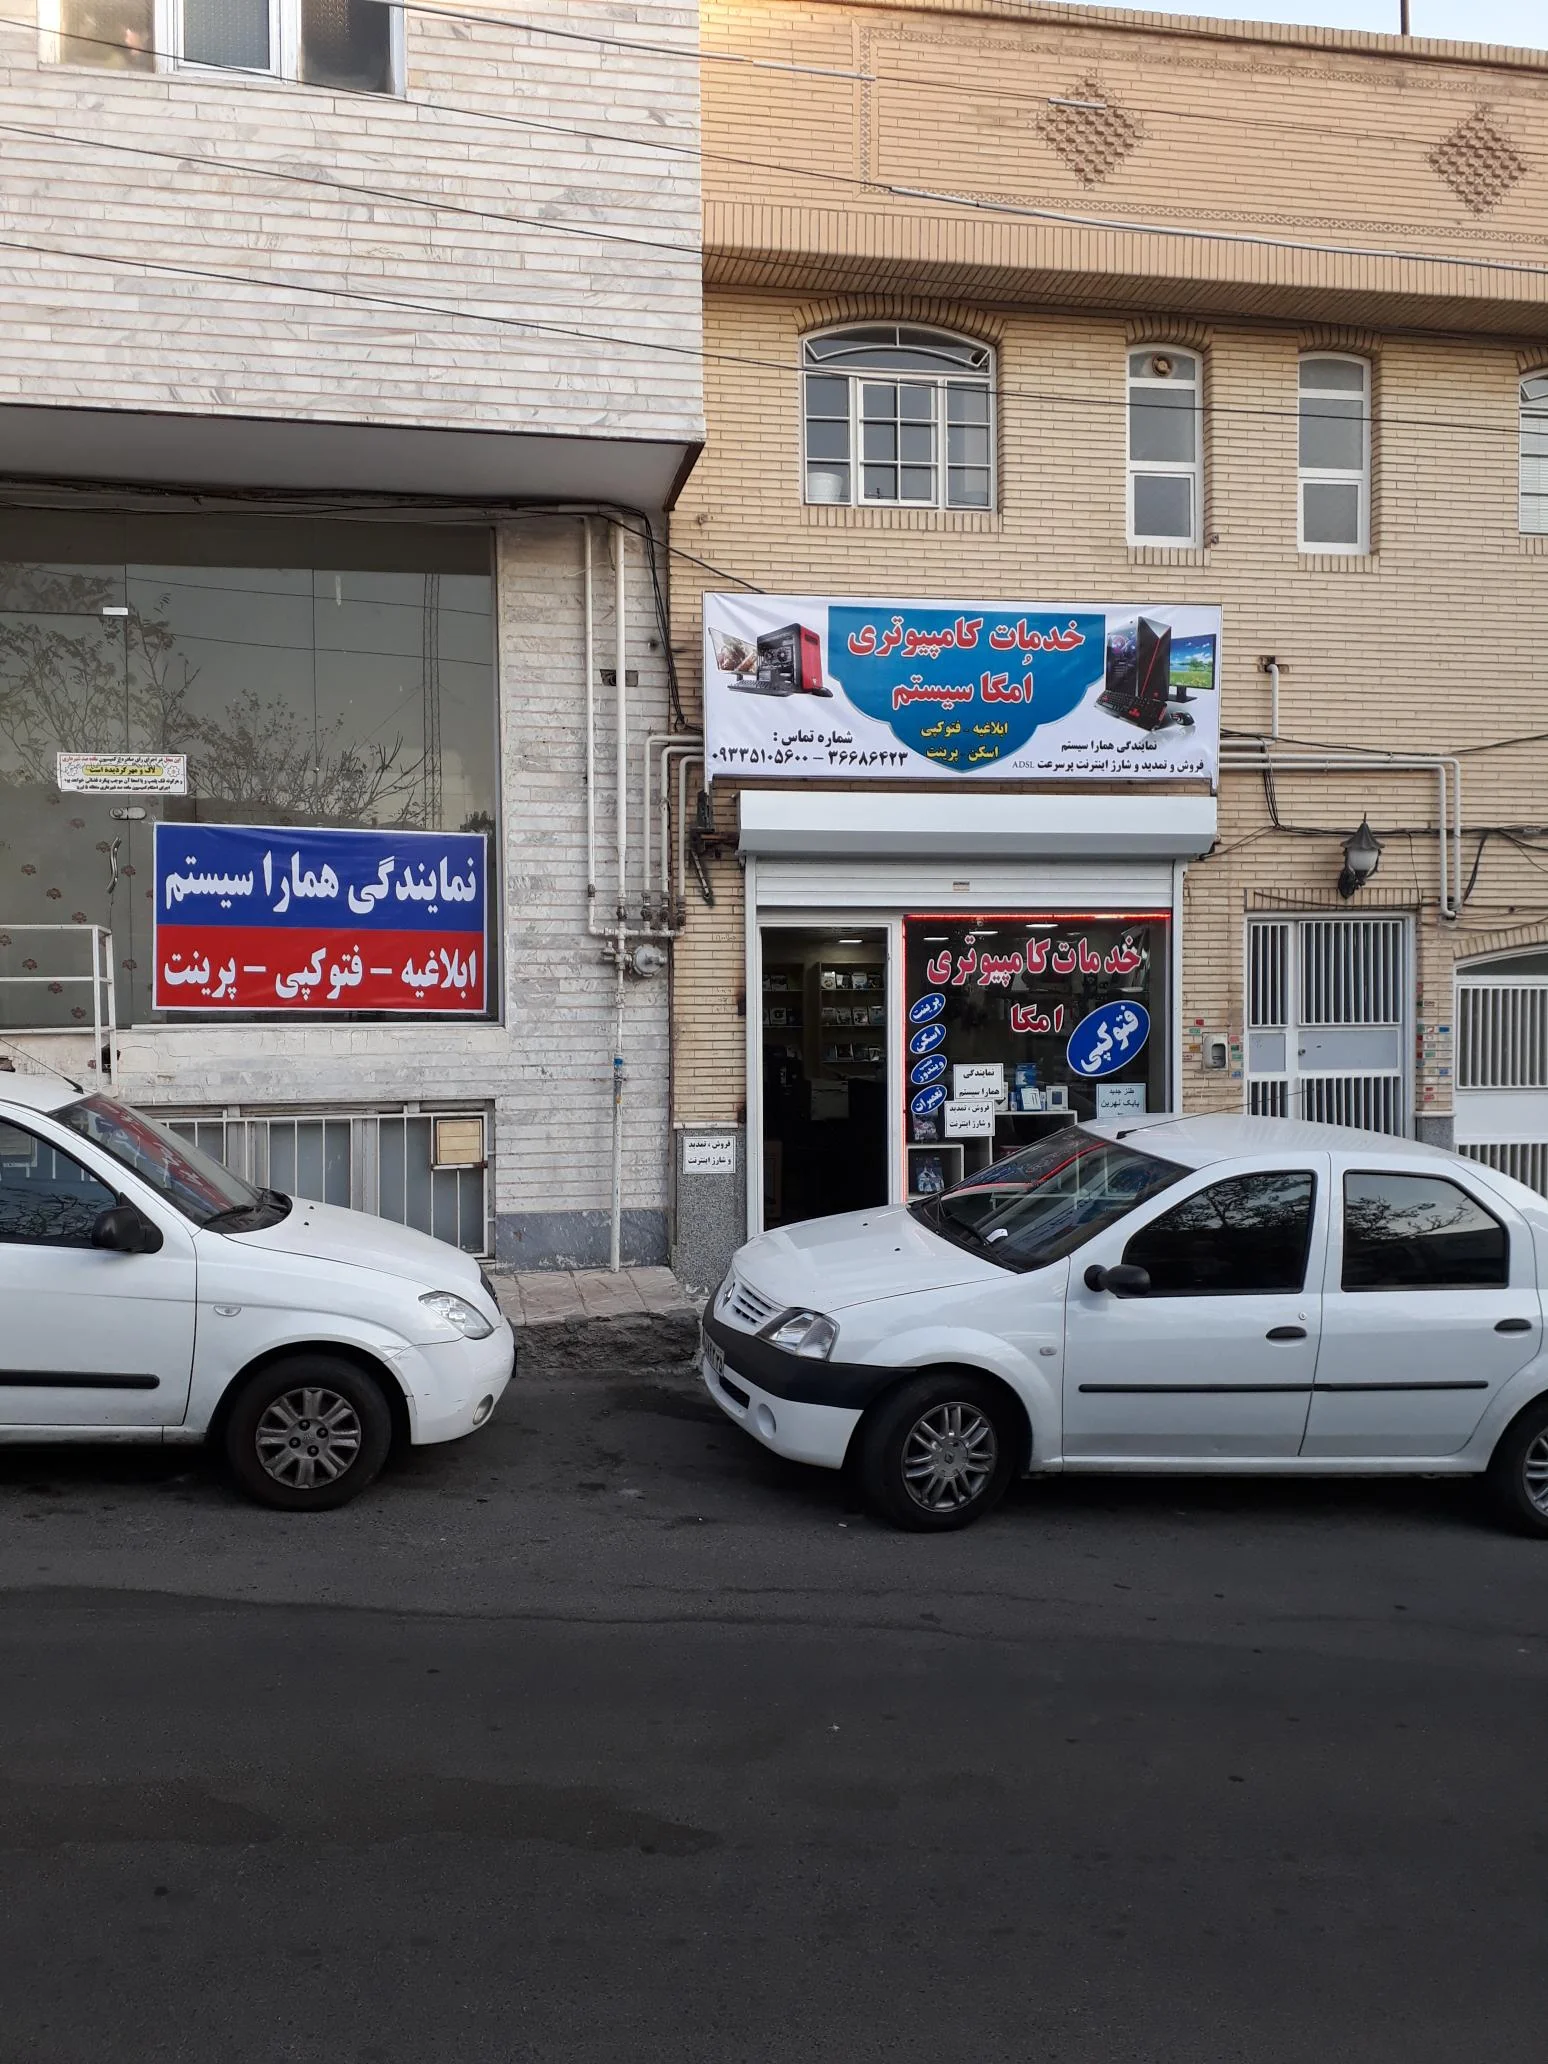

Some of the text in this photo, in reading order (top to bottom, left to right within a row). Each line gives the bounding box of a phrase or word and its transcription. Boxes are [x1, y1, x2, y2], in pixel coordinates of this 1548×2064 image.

[847, 616, 1086, 659] خدمات کامپیوتری
[892, 675, 974, 710] سیستم
[781, 729, 814, 747] تماس
[920, 721, 962, 738] فتوکپی
[972, 722, 1009, 737] ابلاغیه
[817, 730, 853, 748] شماره
[1061, 740, 1157, 754] نمایندگی همارا سیستم
[712, 746, 808, 763] ۰۹۳۳۵۱۰۵۶۰۰
[828, 750, 908, 766] ۳۶۶۸۶۴۲۳
[926, 745, 999, 764] اسکن پرینت
[1012, 759, 1204, 773] فروش و تمدید و شارژ اینترنت پرسرعت ADSL
[165, 850, 476, 914] نمایندگی همارا سیستم
[927, 935, 1142, 987] خدمات کامپیوتری
[164, 950, 236, 1000] پرینت
[275, 945, 362, 1000] فتوکپی
[401, 948, 476, 998] ابلاغیه
[912, 997, 942, 1020] پرینت
[1010, 1002, 1064, 1032] امگا
[916, 1026, 942, 1053] اسکن
[1080, 1004, 1139, 1073] فتوکپی
[917, 1061, 945, 1082] ویندوز
[963, 1068, 995, 1079] نمایندگی
[915, 1087, 943, 1112] تعمیرات
[959, 1087, 1000, 1098] همارا سیستم
[949, 1105, 967, 1113] تمدید
[972, 1105, 990, 1113] فروش
[949, 1119, 971, 1129] اینترنت
[972, 1119, 986, 1128] شارژ
[688, 1140, 707, 1149] تمدید
[711, 1140, 731, 1149] فروش
[687, 1156, 711, 1166] اینترنت
[711, 1156, 726, 1166] شارژ
